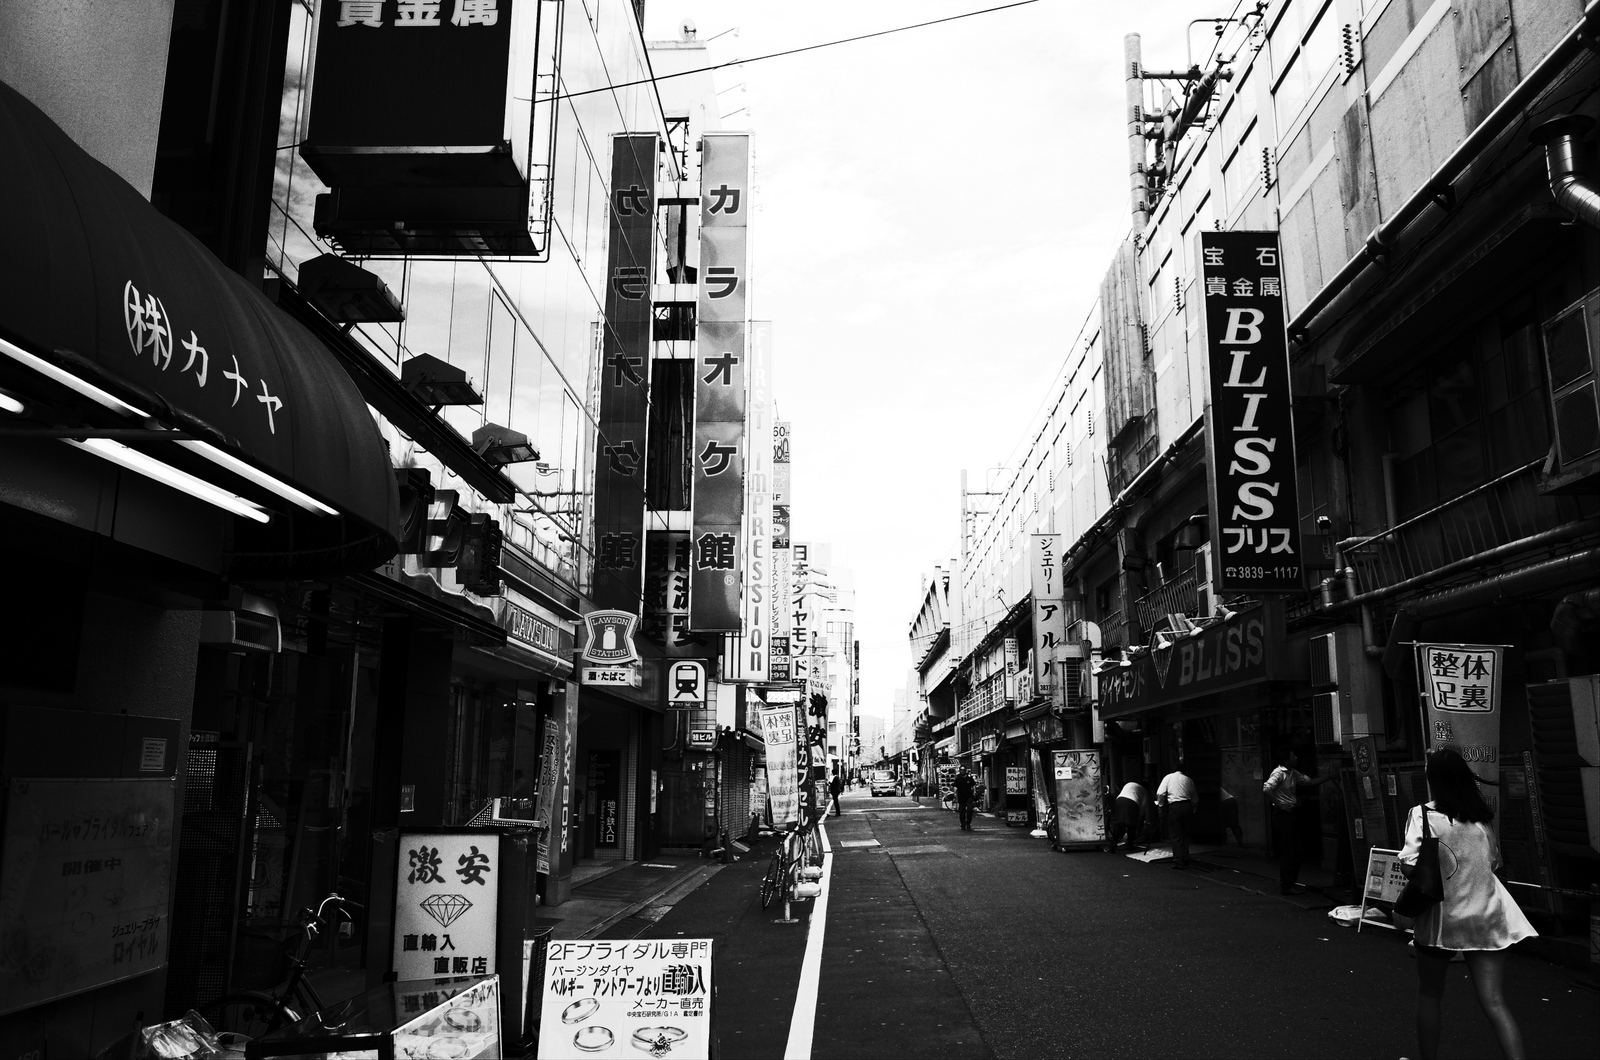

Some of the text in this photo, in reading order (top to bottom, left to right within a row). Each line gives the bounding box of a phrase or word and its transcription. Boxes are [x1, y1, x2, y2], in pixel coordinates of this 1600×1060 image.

[1204, 246, 1277, 266] 宝石
[1205, 276, 1281, 298] 貴金属
[697, 184, 742, 571] カラオケ館
[1219, 307, 1281, 521] BLISS
[1222, 524, 1294, 554] ブリス
[1040, 538, 1054, 594] ジュエリー
[1238, 566, 1299, 579] 3839-1117
[512, 608, 554, 651] LAWSON
[591, 616, 629, 626] LAWSON
[590, 648, 627, 658] STATION
[1179, 616, 1264, 686] BLISS
[1432, 652, 1490, 680] 整体
[1101, 664, 1145, 707] ダイヤモンド
[1436, 681, 1489, 709] 足裏
[606, 800, 616, 843] 地下鉄入口
[62, 857, 121, 877] 開催中
[407, 845, 491, 886] 激安
[113, 931, 158, 965] ロイヤル
[403, 934, 456, 951] 直輸入
[548, 941, 708, 961] 2Fブライダル専門
[434, 957, 487, 974] 直販店
[552, 964, 634, 977] バージンダイヤ
[632, 998, 704, 1010] メーカー直売
